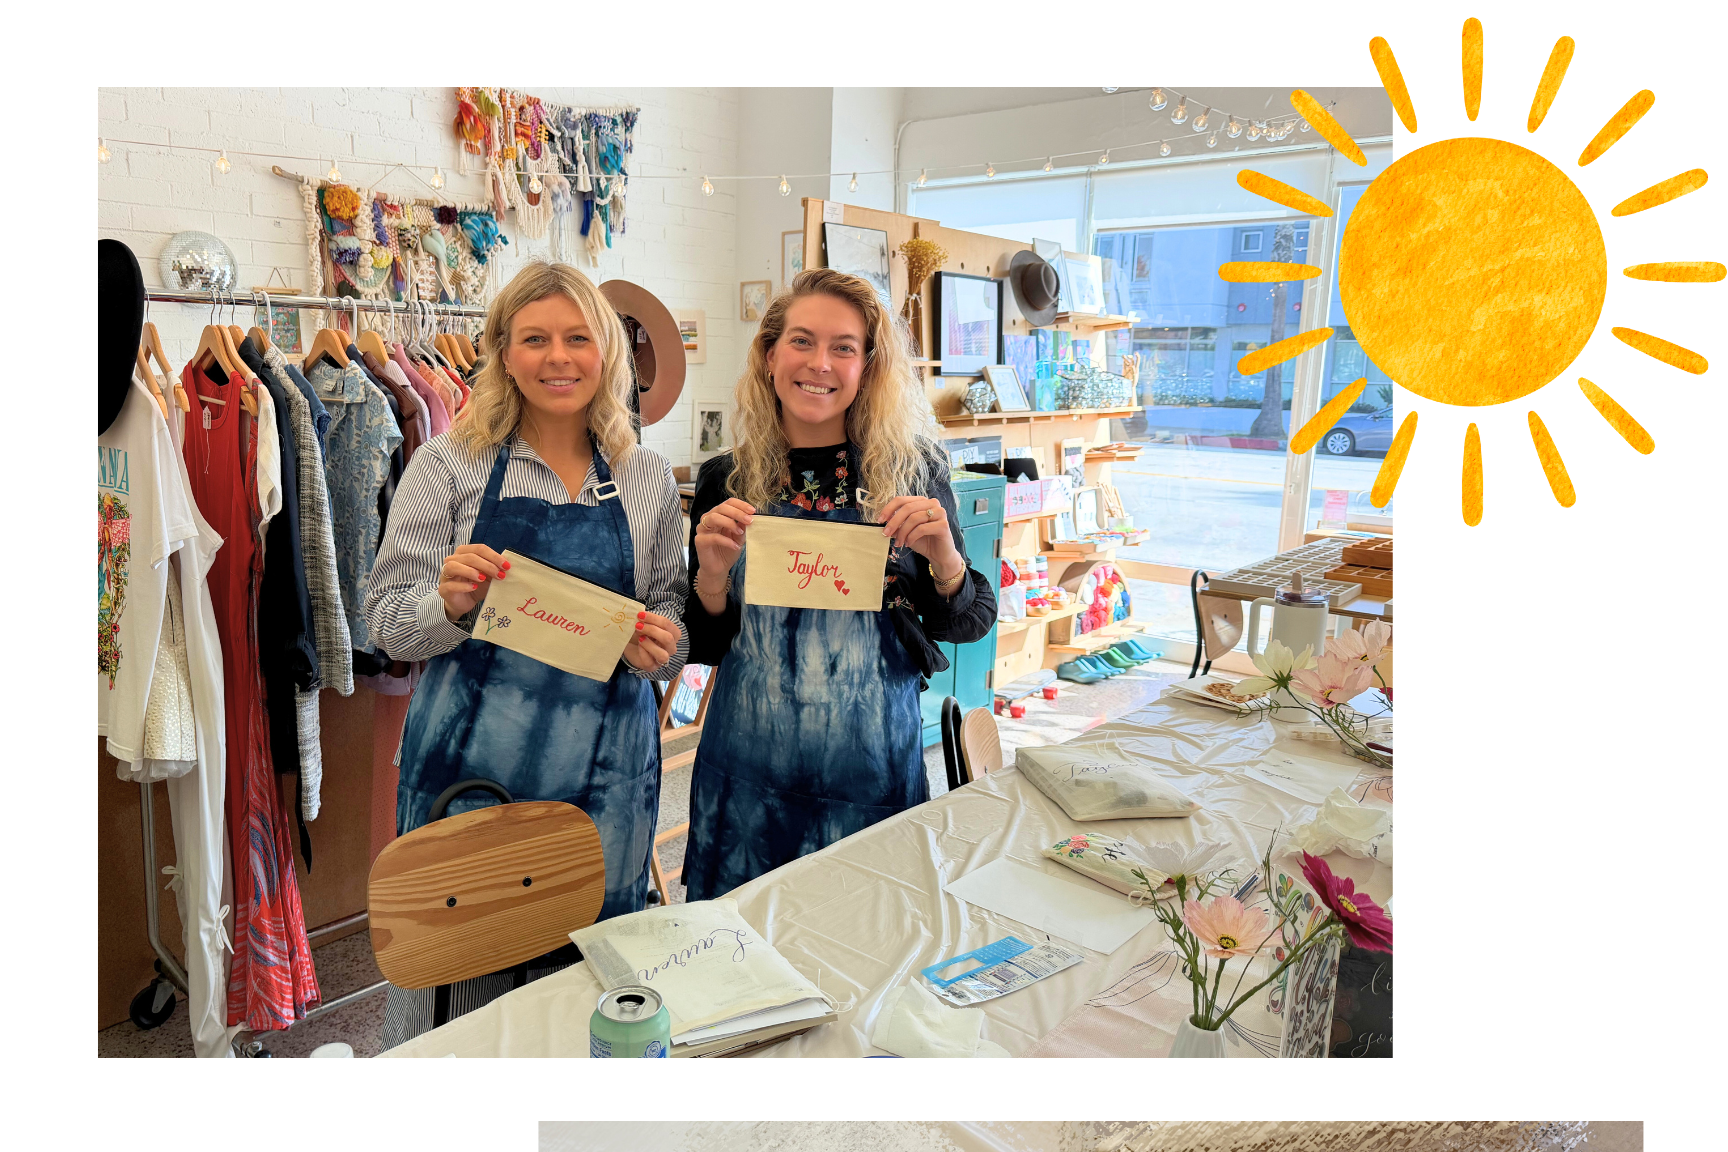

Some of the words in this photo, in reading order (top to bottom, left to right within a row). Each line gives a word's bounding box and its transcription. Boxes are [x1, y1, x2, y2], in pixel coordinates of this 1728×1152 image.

[787, 550, 843, 590] Taylor
[516, 596, 591, 636] Lauren
[637, 928, 754, 981] Lauren
